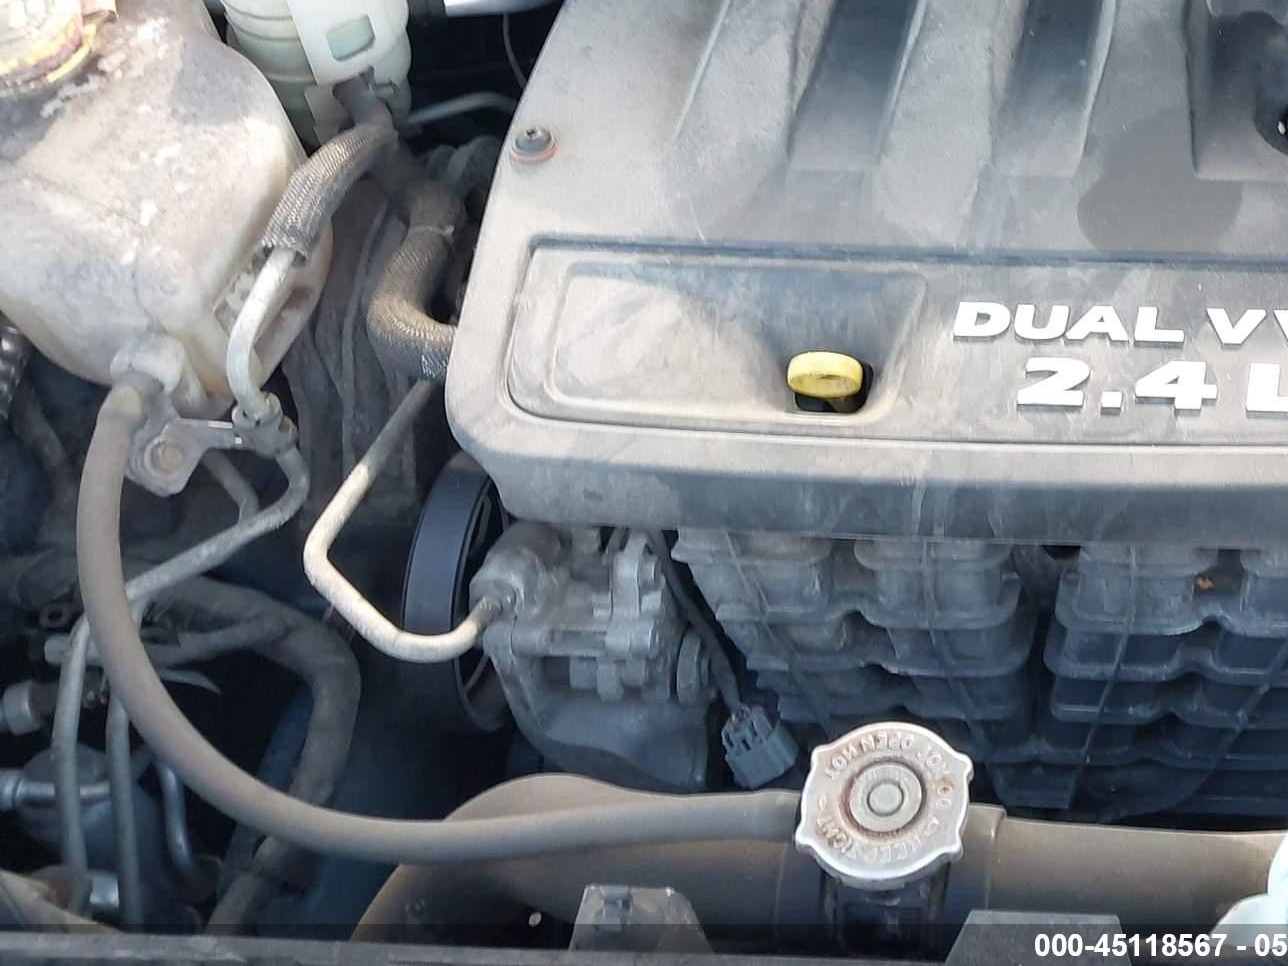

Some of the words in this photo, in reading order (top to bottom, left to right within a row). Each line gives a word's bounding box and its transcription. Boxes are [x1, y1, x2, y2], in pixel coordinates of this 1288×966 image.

[953, 301, 1186, 346] DUAL
[1015, 356, 1218, 416] 2.4
[860, 731, 915, 753] OPEN
